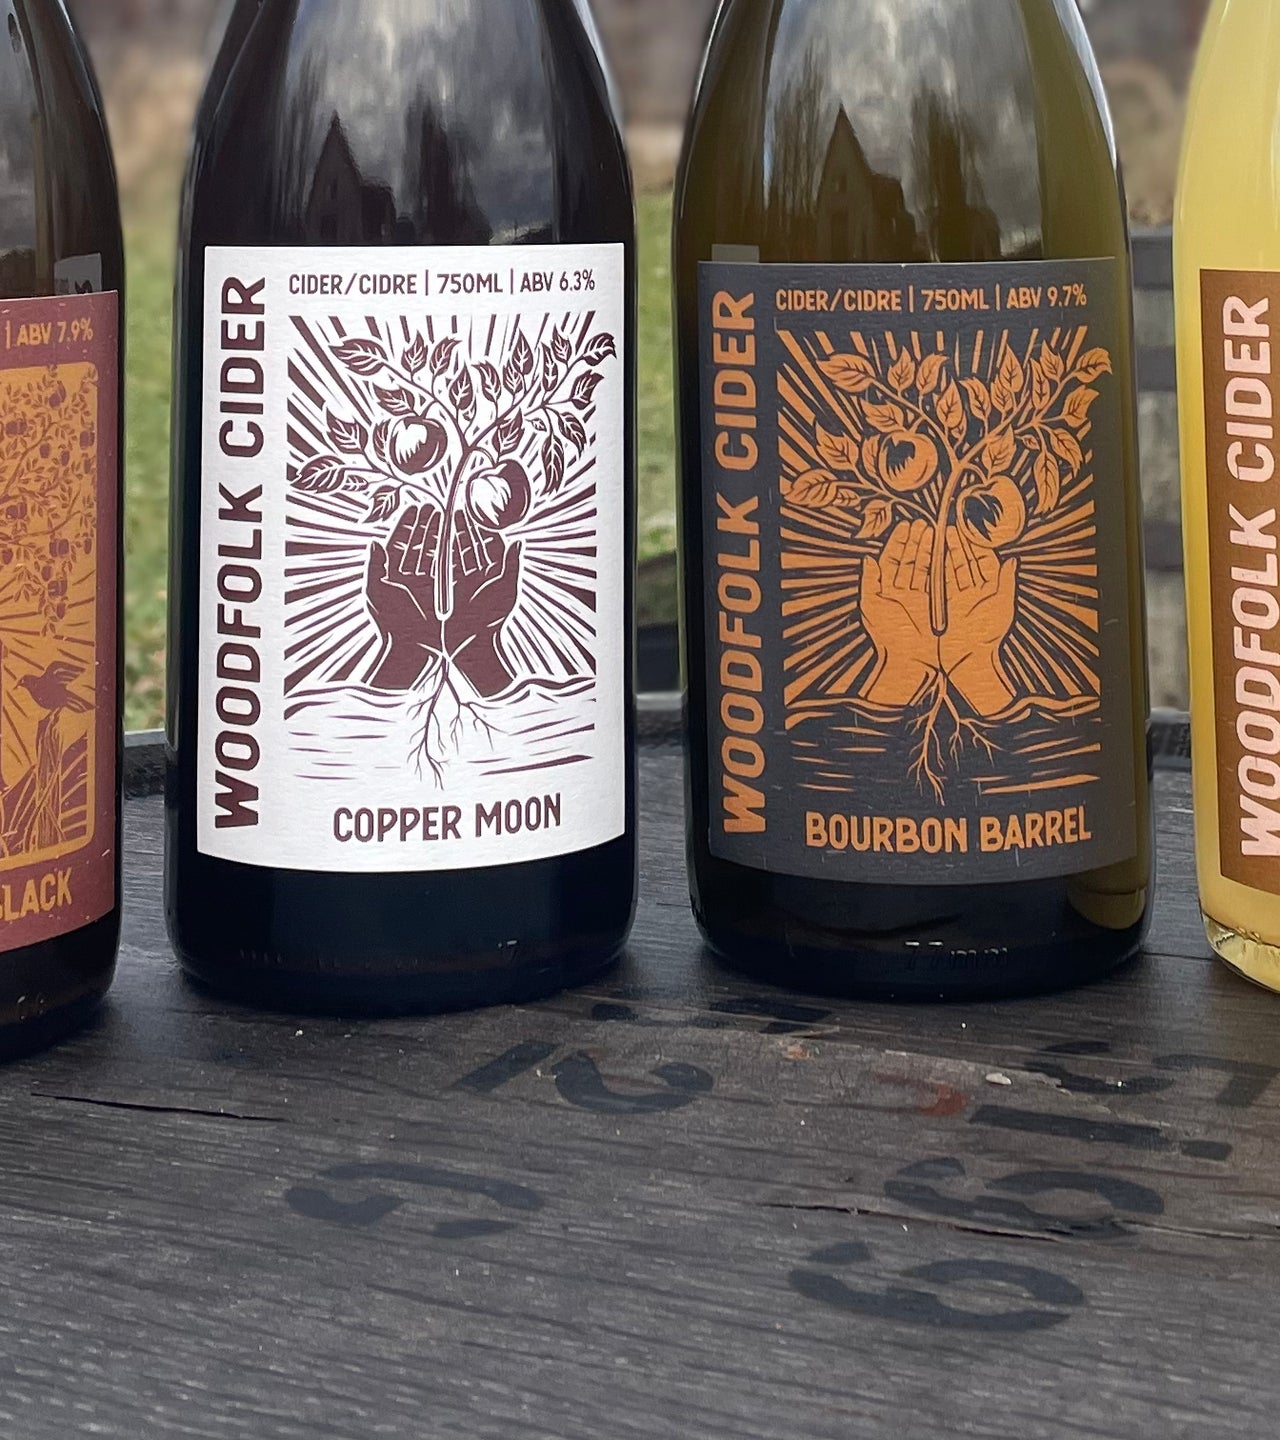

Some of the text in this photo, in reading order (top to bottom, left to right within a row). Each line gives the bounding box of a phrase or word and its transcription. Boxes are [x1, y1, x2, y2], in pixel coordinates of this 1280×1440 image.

[288, 268, 596, 296] CIDER/CIDRE 750ML ABV 6.3%
[775, 283, 1089, 312] CIDER/CIDRE 750ML ABV 9.7%
[16, 322, 54, 346] ABV
[57, 317, 94, 342] 7.9%
[1223, 294, 1277, 483] CIDER
[215, 275, 266, 830] WOODFOLK CIDER
[712, 289, 766, 836] WOODFOLK CIDER
[333, 792, 561, 843] COPPER MOON
[805, 806, 1093, 854] BOURBON BARREL
